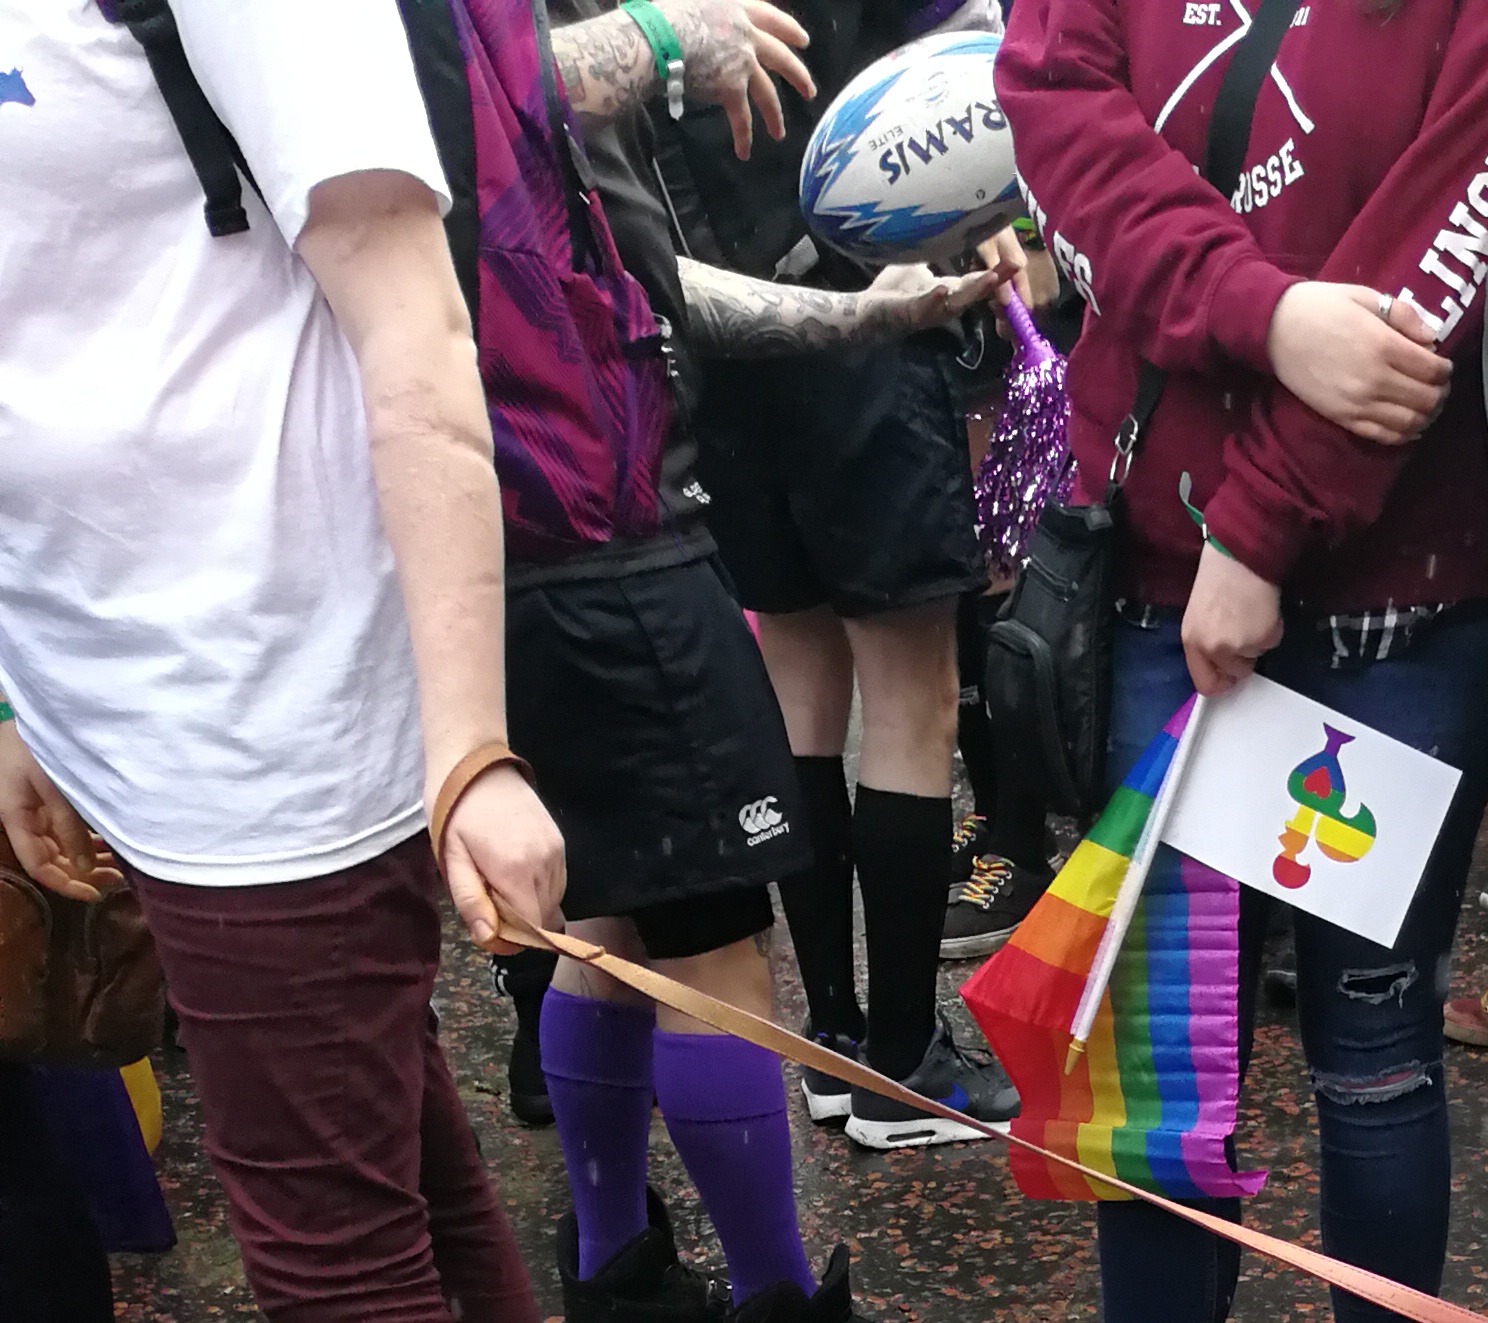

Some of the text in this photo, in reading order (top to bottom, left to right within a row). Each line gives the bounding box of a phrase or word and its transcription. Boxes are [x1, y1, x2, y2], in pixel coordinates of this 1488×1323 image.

[1183, 2, 1222, 26] EST.
[868, 125, 904, 151] ELITE
[1229, 137, 1305, 214] ROSSE
